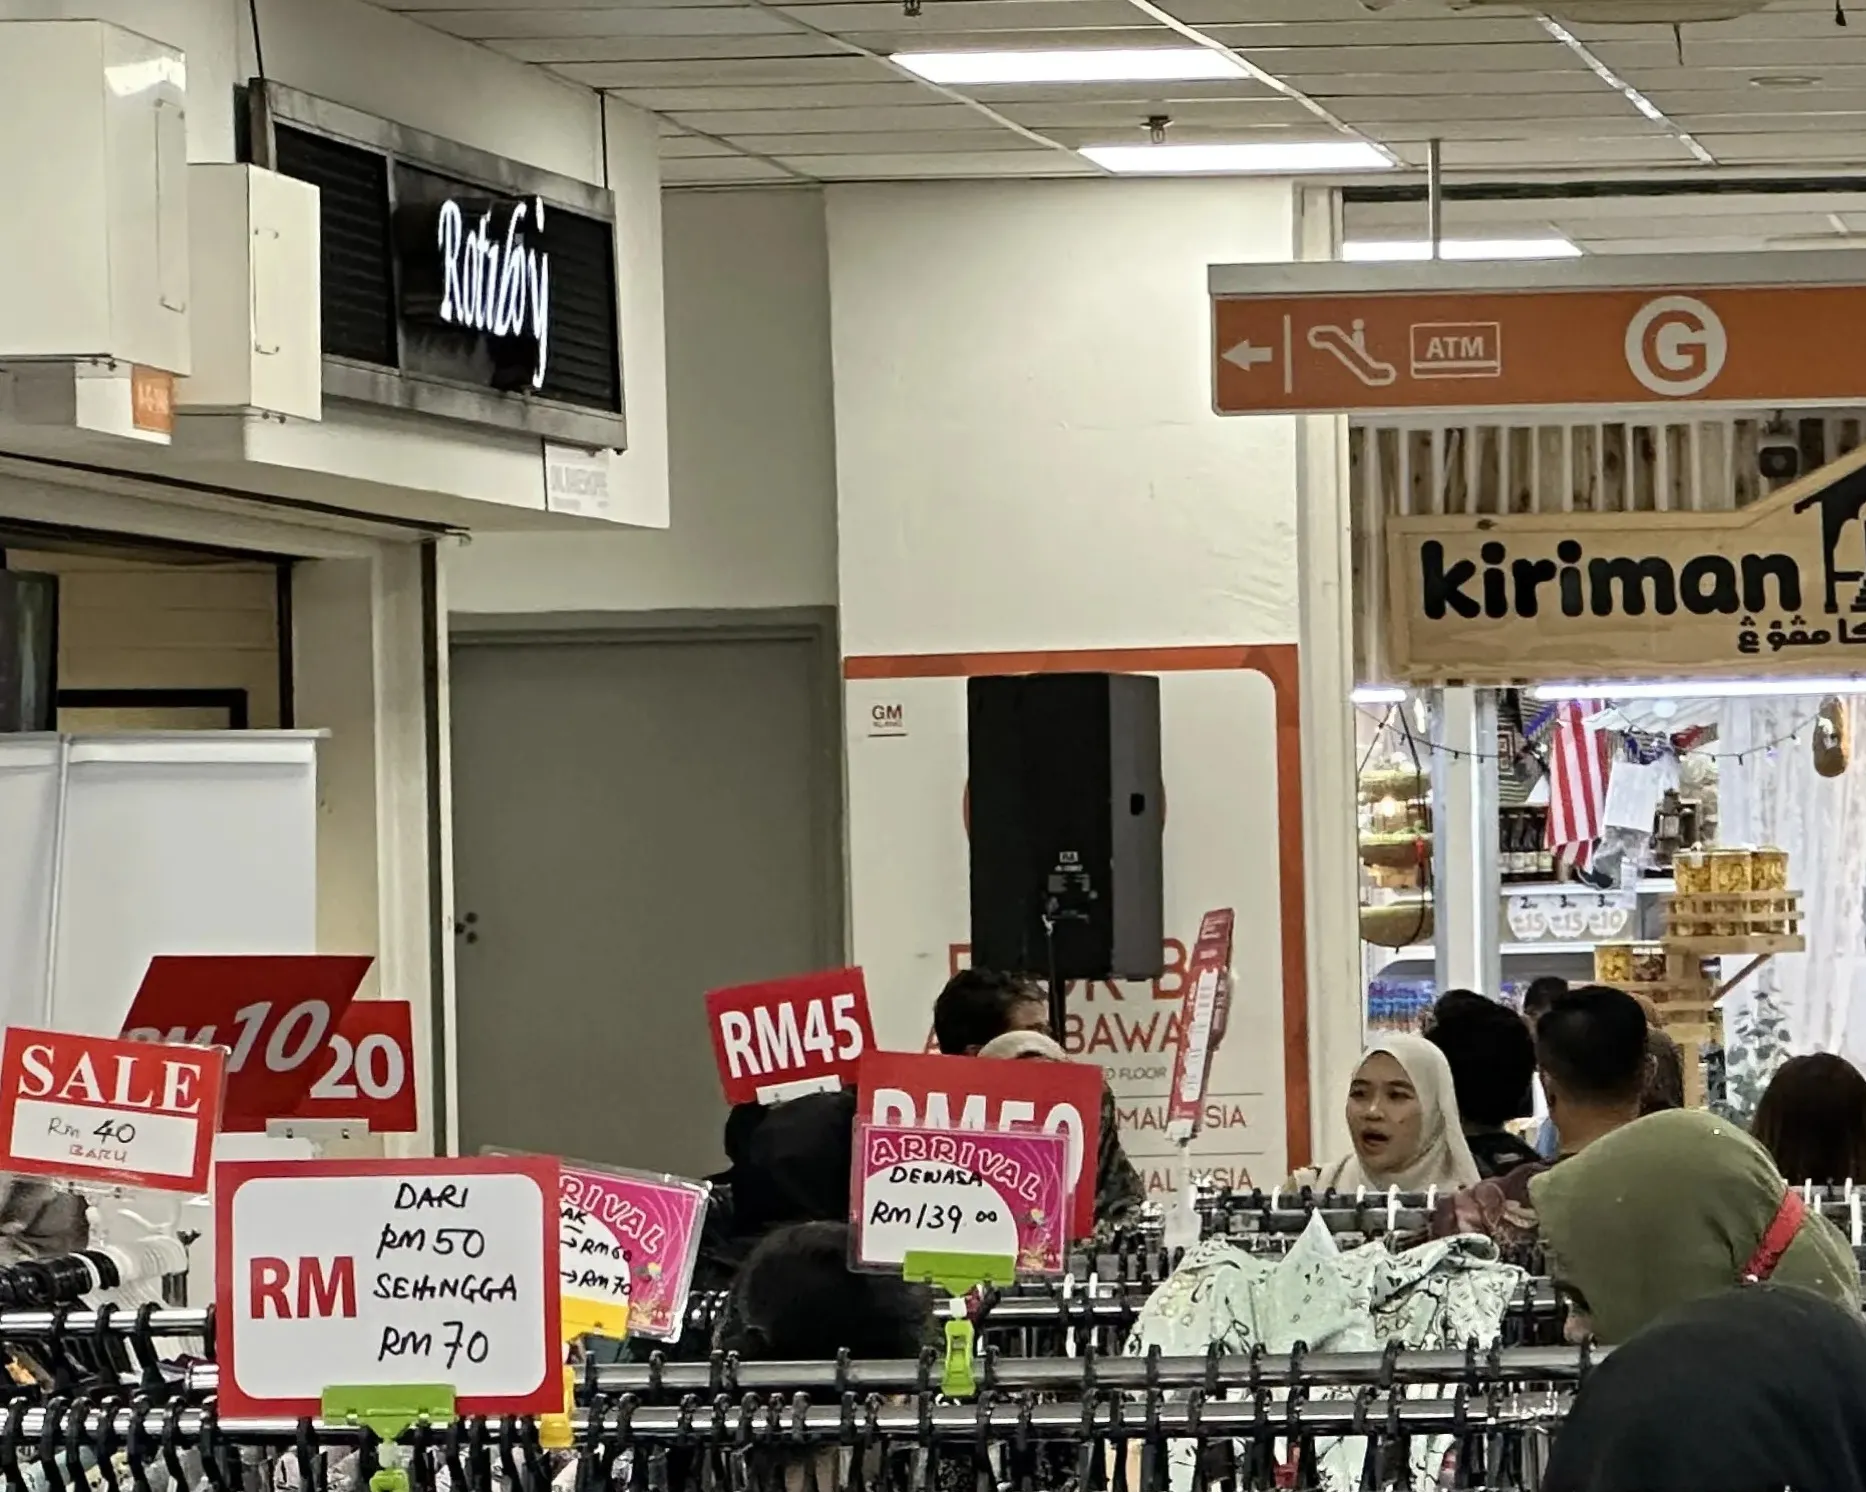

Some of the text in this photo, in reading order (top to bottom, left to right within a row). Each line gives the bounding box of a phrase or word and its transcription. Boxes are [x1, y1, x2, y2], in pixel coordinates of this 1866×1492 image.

[1426, 335, 1485, 359] ATM
[1639, 306, 1711, 386] G
[1420, 539, 1802, 619] kiriman
[872, 703, 903, 720] GM
[226, 999, 331, 1073] 10
[719, 993, 864, 1079] RM45
[1065, 1012, 1188, 1055] BAWA
[17, 1045, 202, 1114] SALE
[309, 1033, 405, 1100] 20
[93, 1119, 136, 1144] 40
[1116, 1104, 1248, 1131] MALSIA
[68, 1144, 129, 1163] BARU
[872, 1134, 1042, 1201] ARRIVAL
[888, 1165, 984, 1187] DEWASA
[394, 1182, 469, 1210] DARI
[559, 1174, 666, 1255] RIVAL
[249, 1255, 358, 1320] RM
